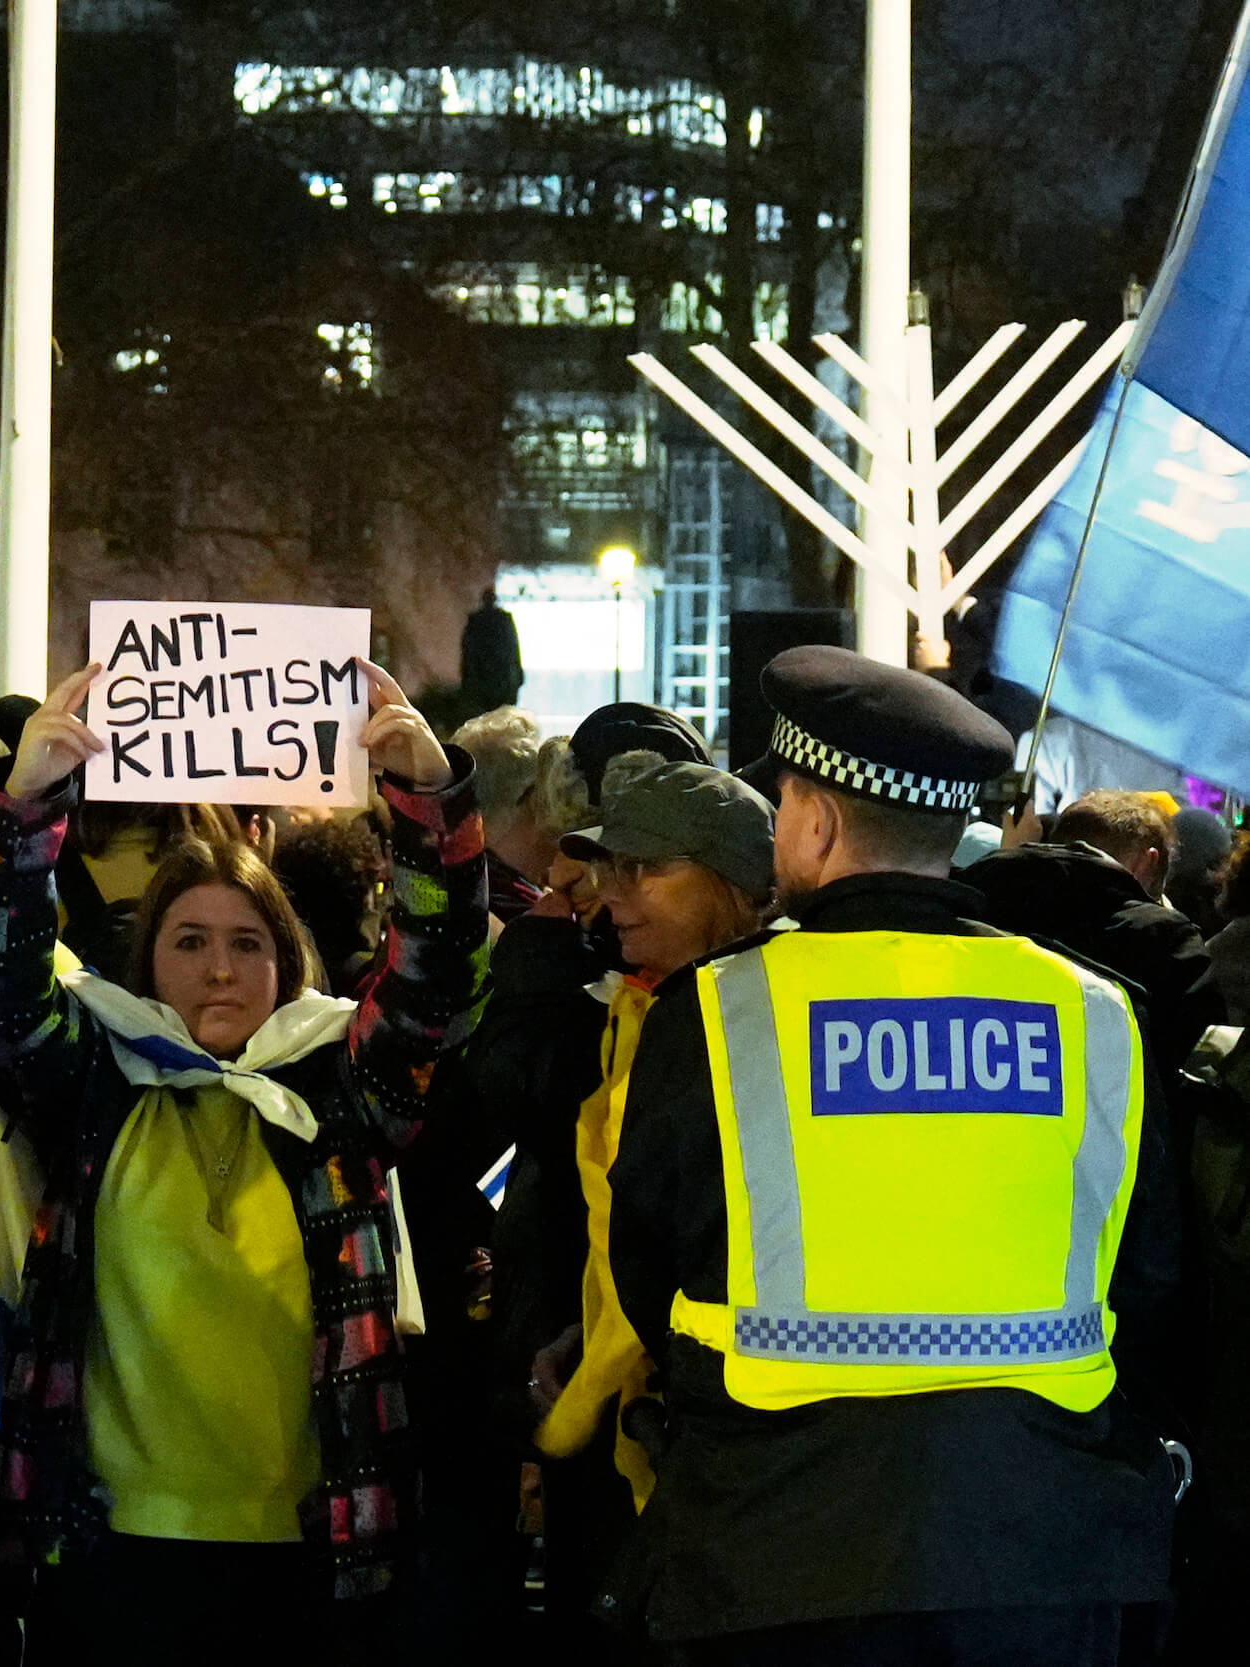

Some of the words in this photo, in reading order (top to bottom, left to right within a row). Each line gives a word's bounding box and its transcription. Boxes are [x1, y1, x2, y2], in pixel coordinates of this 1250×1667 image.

[107, 612, 257, 672] ANTI-
[106, 656, 359, 727] SEMITISM
[111, 719, 340, 793] KILLS!
[823, 1017, 1051, 1092] POLICE
